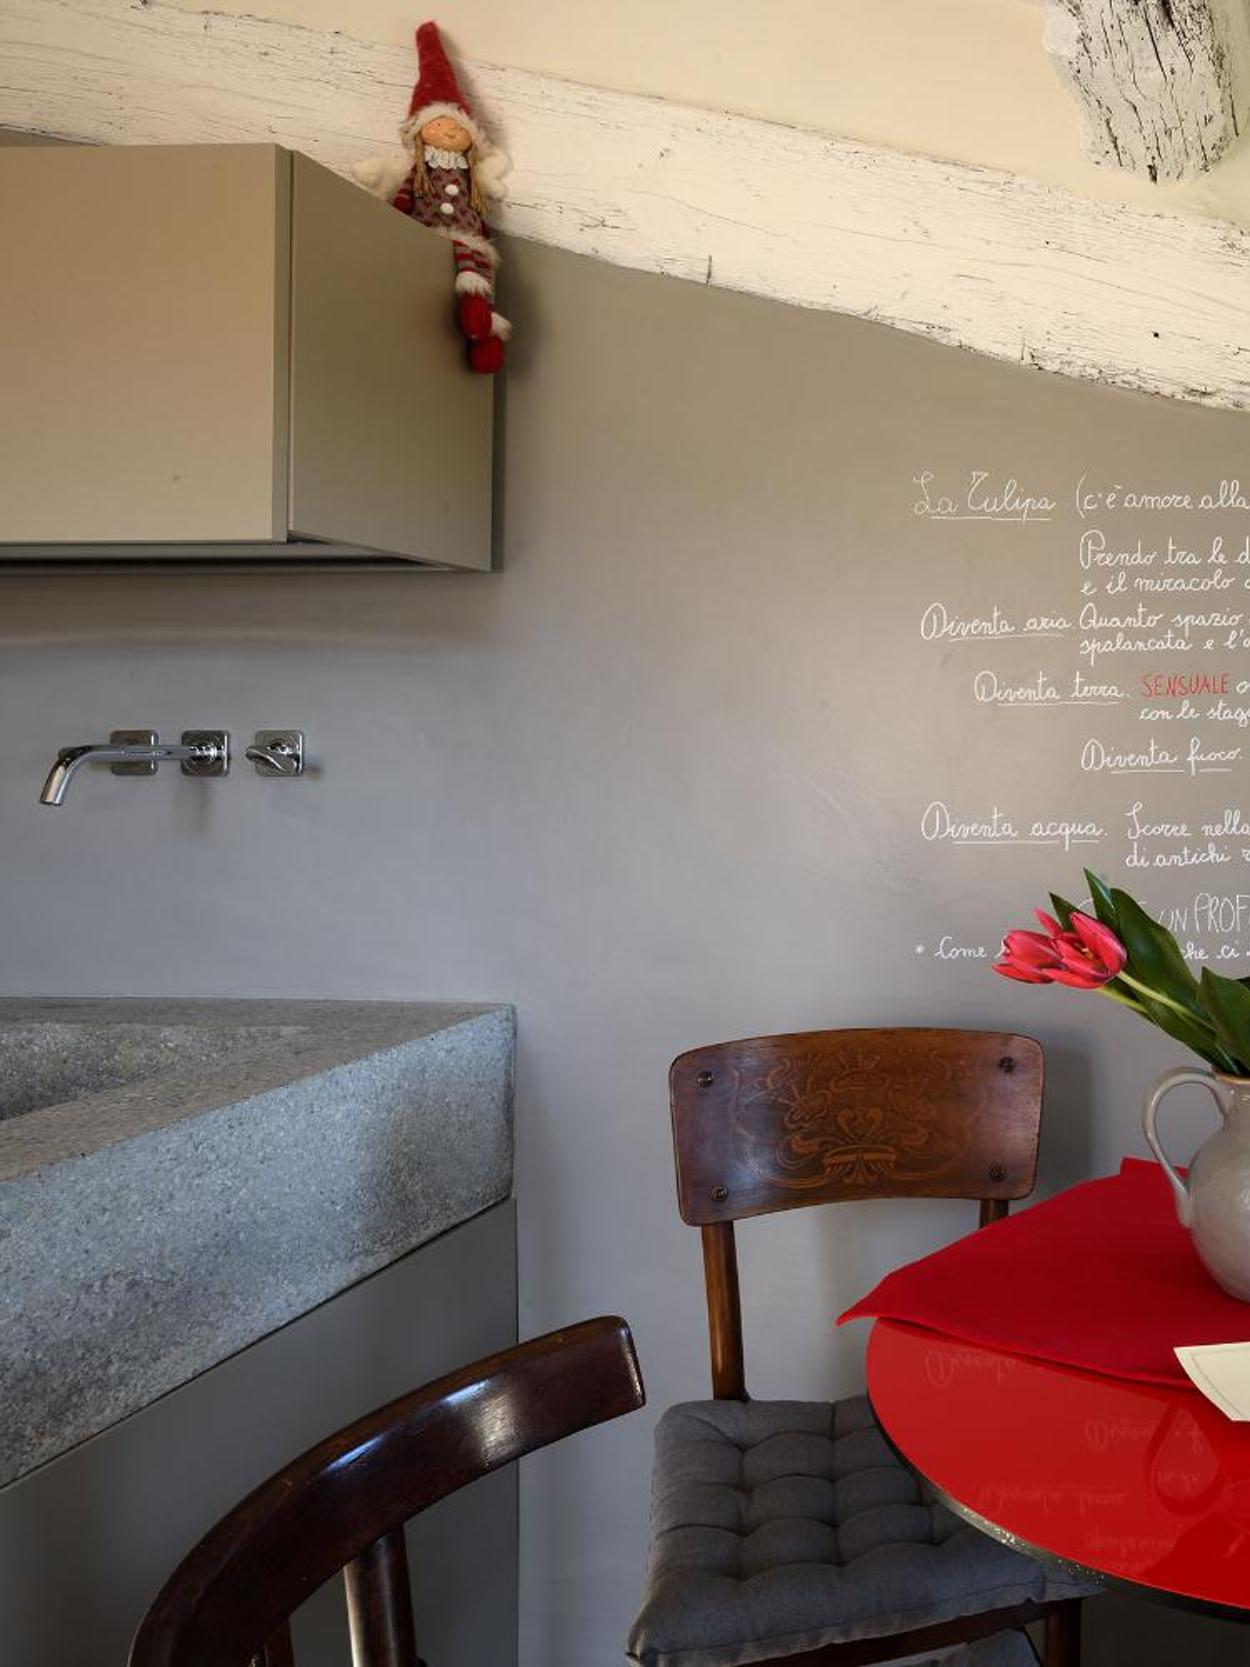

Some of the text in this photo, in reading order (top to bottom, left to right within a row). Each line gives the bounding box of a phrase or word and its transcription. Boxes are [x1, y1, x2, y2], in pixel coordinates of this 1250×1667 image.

[914, 472, 958, 514] La
[967, 472, 1055, 523] Tulipa
[1121, 489, 1191, 510] amore
[1198, 480, 1250, 510] alla
[1080, 530, 1156, 569] Prendo
[1164, 536, 1201, 566] tra
[1208, 536, 1227, 564] le
[1080, 579, 1097, 595] e
[1106, 571, 1127, 593] il
[1134, 569, 1235, 592] miracolo
[921, 603, 1015, 640] Diventa
[1079, 602, 1161, 631] Quanto
[1171, 607, 1243, 639] spazio
[1080, 628, 1191, 666] spalancata
[1202, 637, 1214, 650] e
[975, 670, 1060, 702] Diventa
[1069, 670, 1130, 699] terra.
[1142, 672, 1230, 699] SENSUALE
[1140, 706, 1173, 720] con
[1176, 700, 1200, 720] le
[1081, 738, 1178, 771] Diventa
[921, 801, 1018, 840] Diventa
[1028, 818, 1107, 850] acqua.
[1125, 842, 1150, 868] di
[1152, 842, 1231, 867] antichi
[934, 936, 987, 960] Come
[1217, 941, 1239, 959] ci
